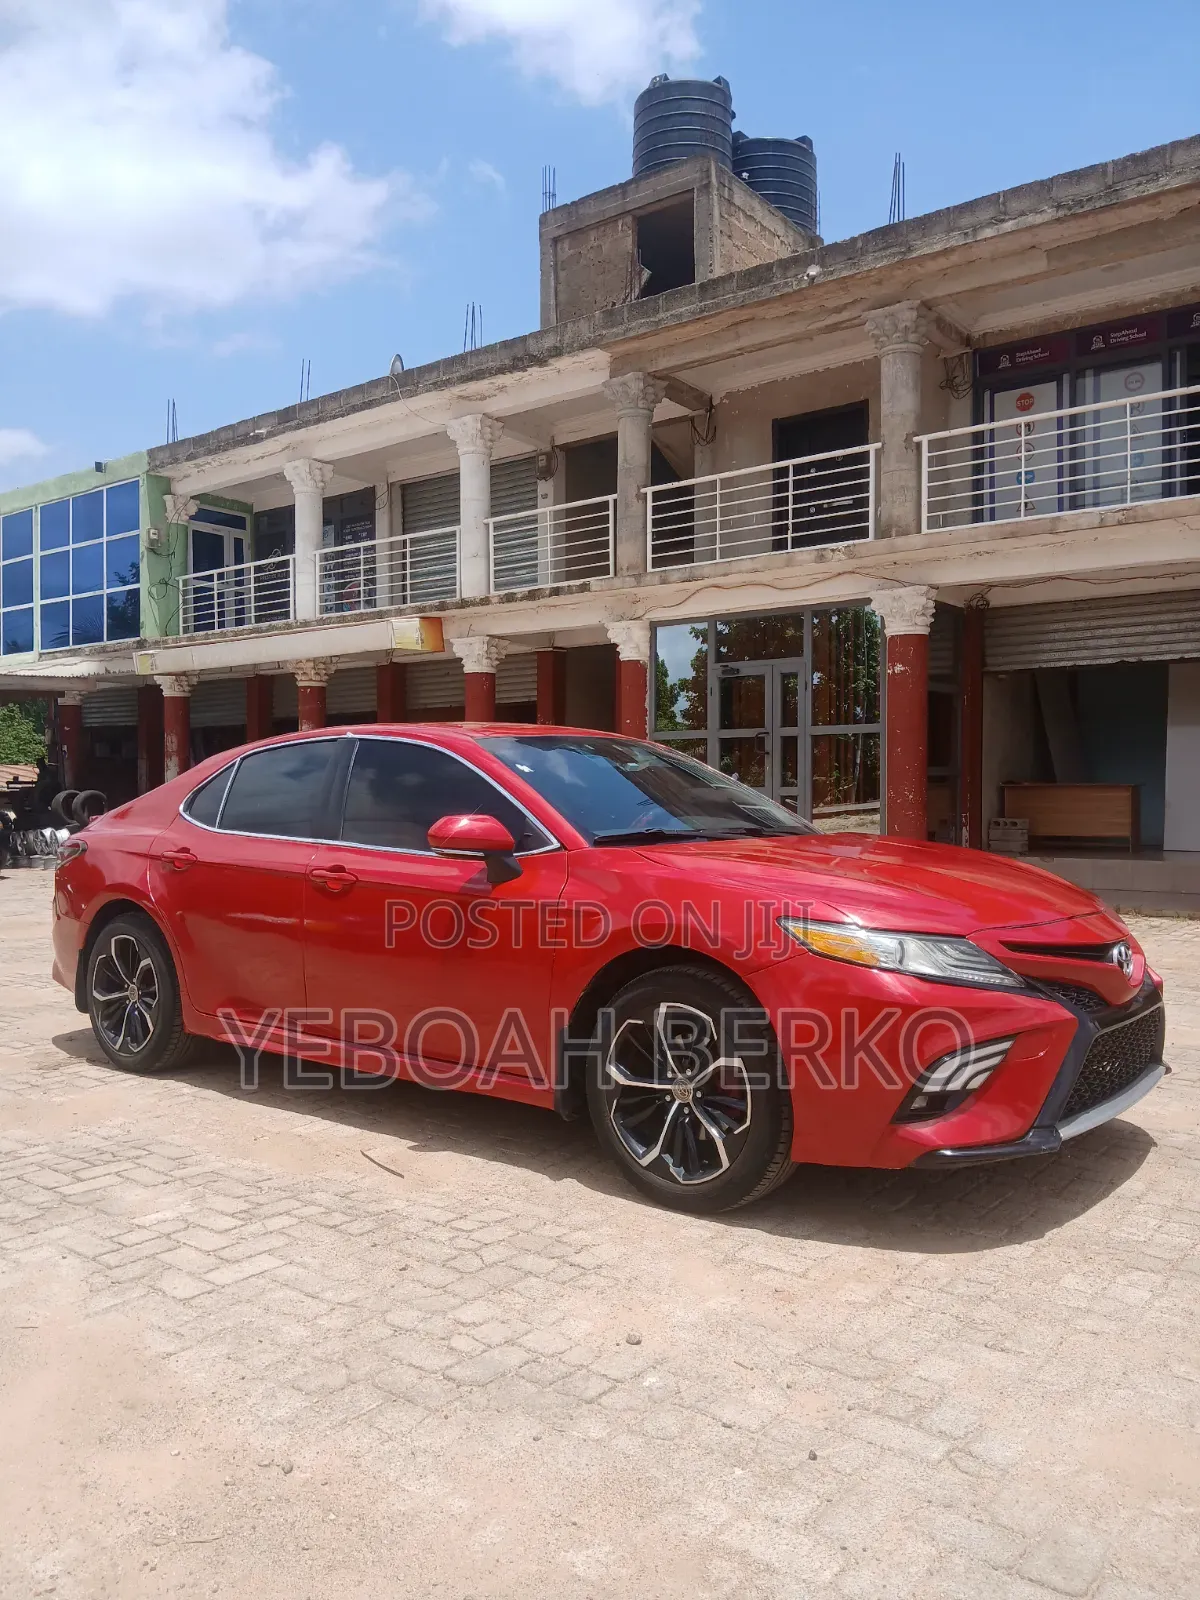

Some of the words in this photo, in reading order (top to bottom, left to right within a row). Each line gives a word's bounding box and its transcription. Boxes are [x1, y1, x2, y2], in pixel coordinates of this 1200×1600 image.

[1110, 336, 1129, 344] Driving
[1129, 331, 1147, 340] School
[1033, 350, 1050, 359] School
[1016, 398, 1034, 407] STOP
